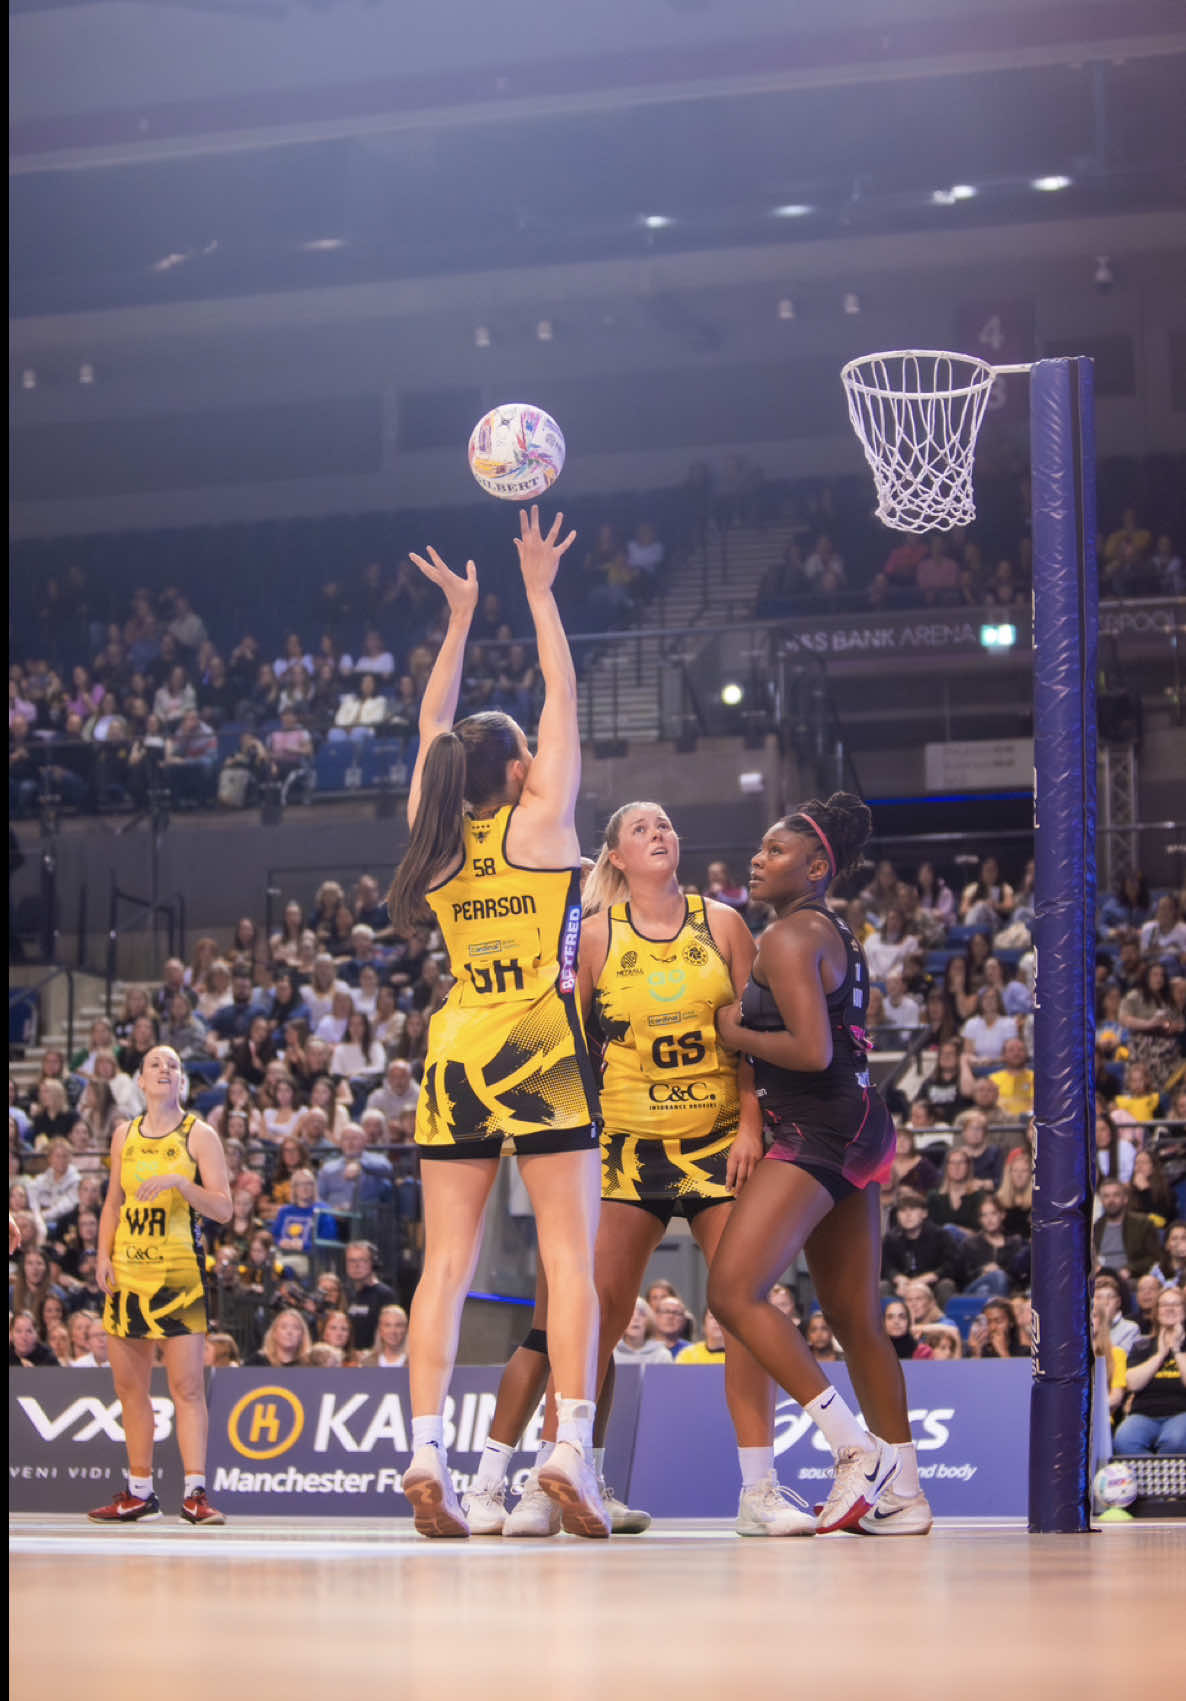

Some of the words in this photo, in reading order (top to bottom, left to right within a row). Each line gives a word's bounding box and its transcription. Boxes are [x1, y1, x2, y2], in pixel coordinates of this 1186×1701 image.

[979, 316, 1004, 349] 4
[832, 627, 895, 651] BANK
[900, 622, 977, 646] ARENA
[473, 858, 495, 877] 58
[452, 896, 536, 922] PEARSON
[560, 907, 581, 990] BETFRED
[652, 1030, 705, 1068] GS
[126, 1208, 165, 1236] WA
[9, 1466, 57, 1479] VENI
[69, 1466, 111, 1479] VIDI
[213, 1466, 375, 1493] Manchester
[937, 1464, 978, 1481] body
